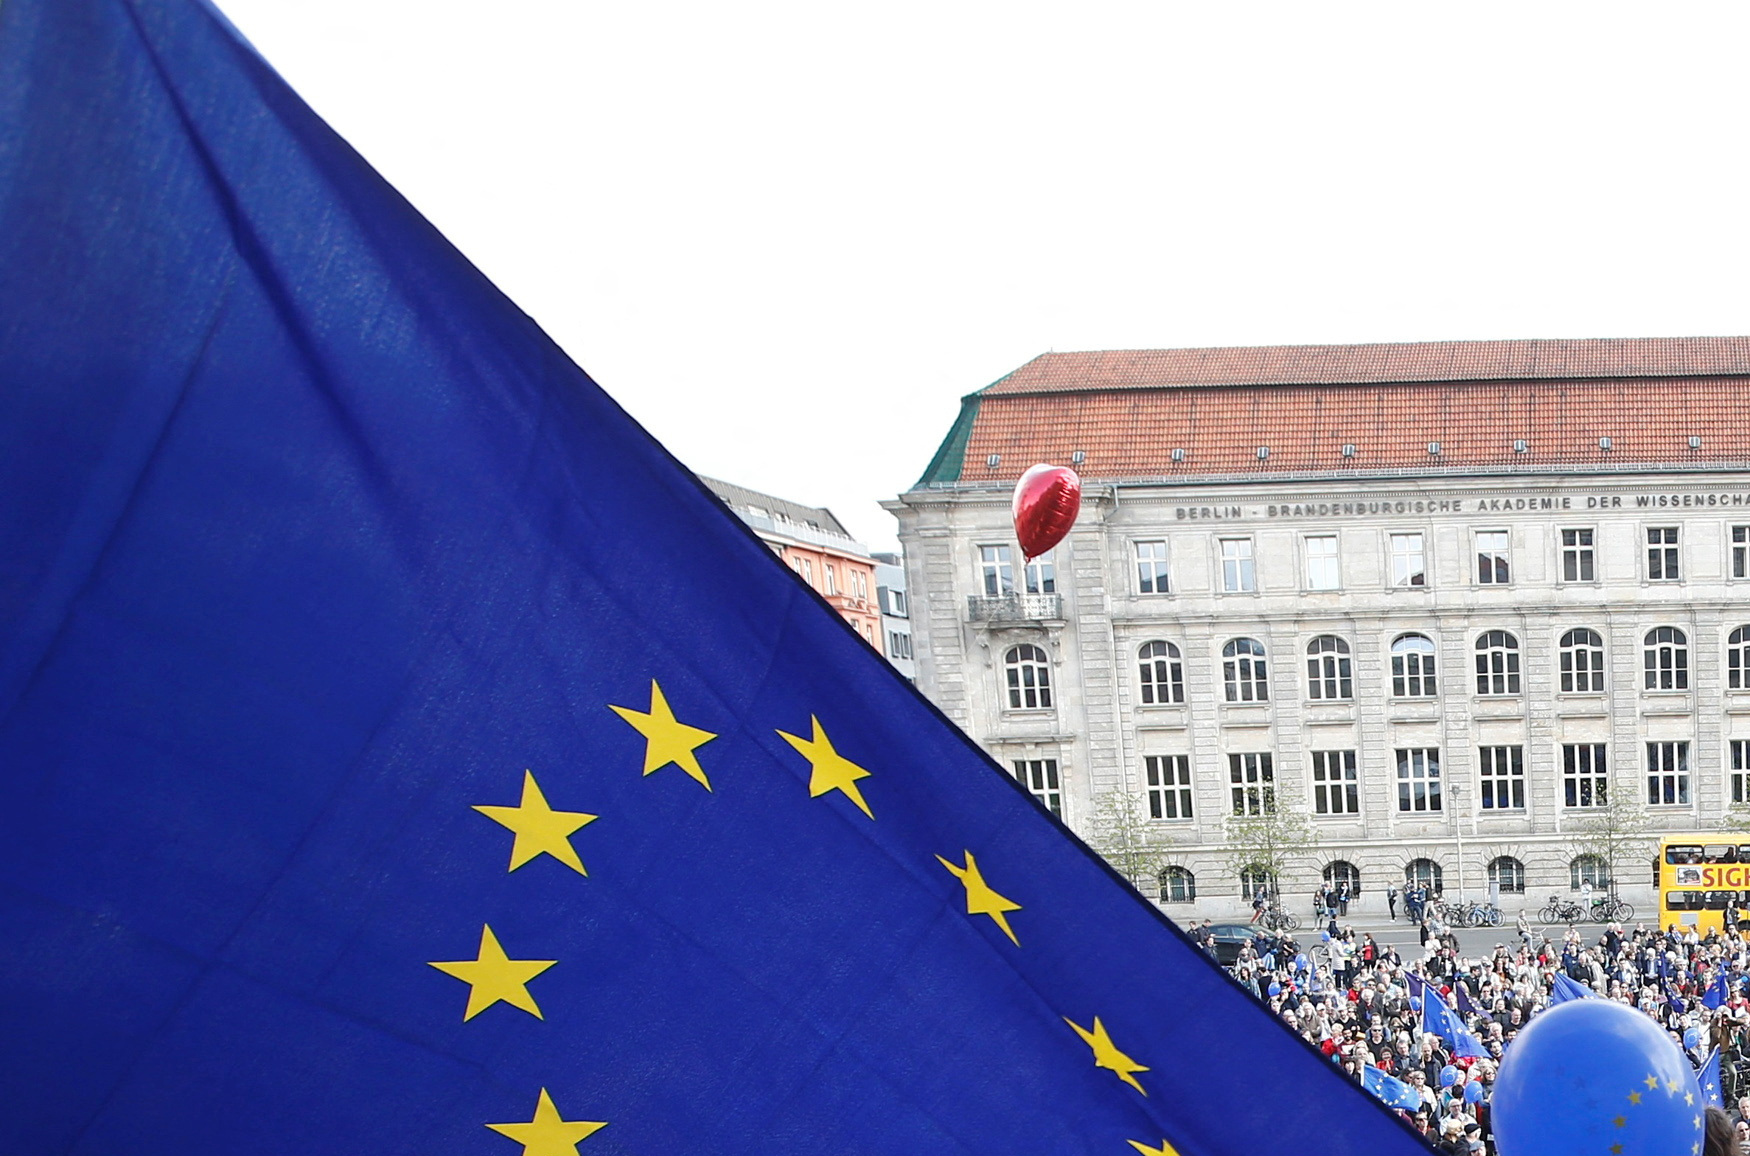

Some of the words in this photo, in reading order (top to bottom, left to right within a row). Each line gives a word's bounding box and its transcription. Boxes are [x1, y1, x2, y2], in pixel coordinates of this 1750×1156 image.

[1176, 506, 1242, 520] BERLIN
[1267, 499, 1462, 517] BRANDENBURGISCHE
[1477, 497, 1572, 511] AKADEMIE
[1587, 496, 1622, 508] DER
